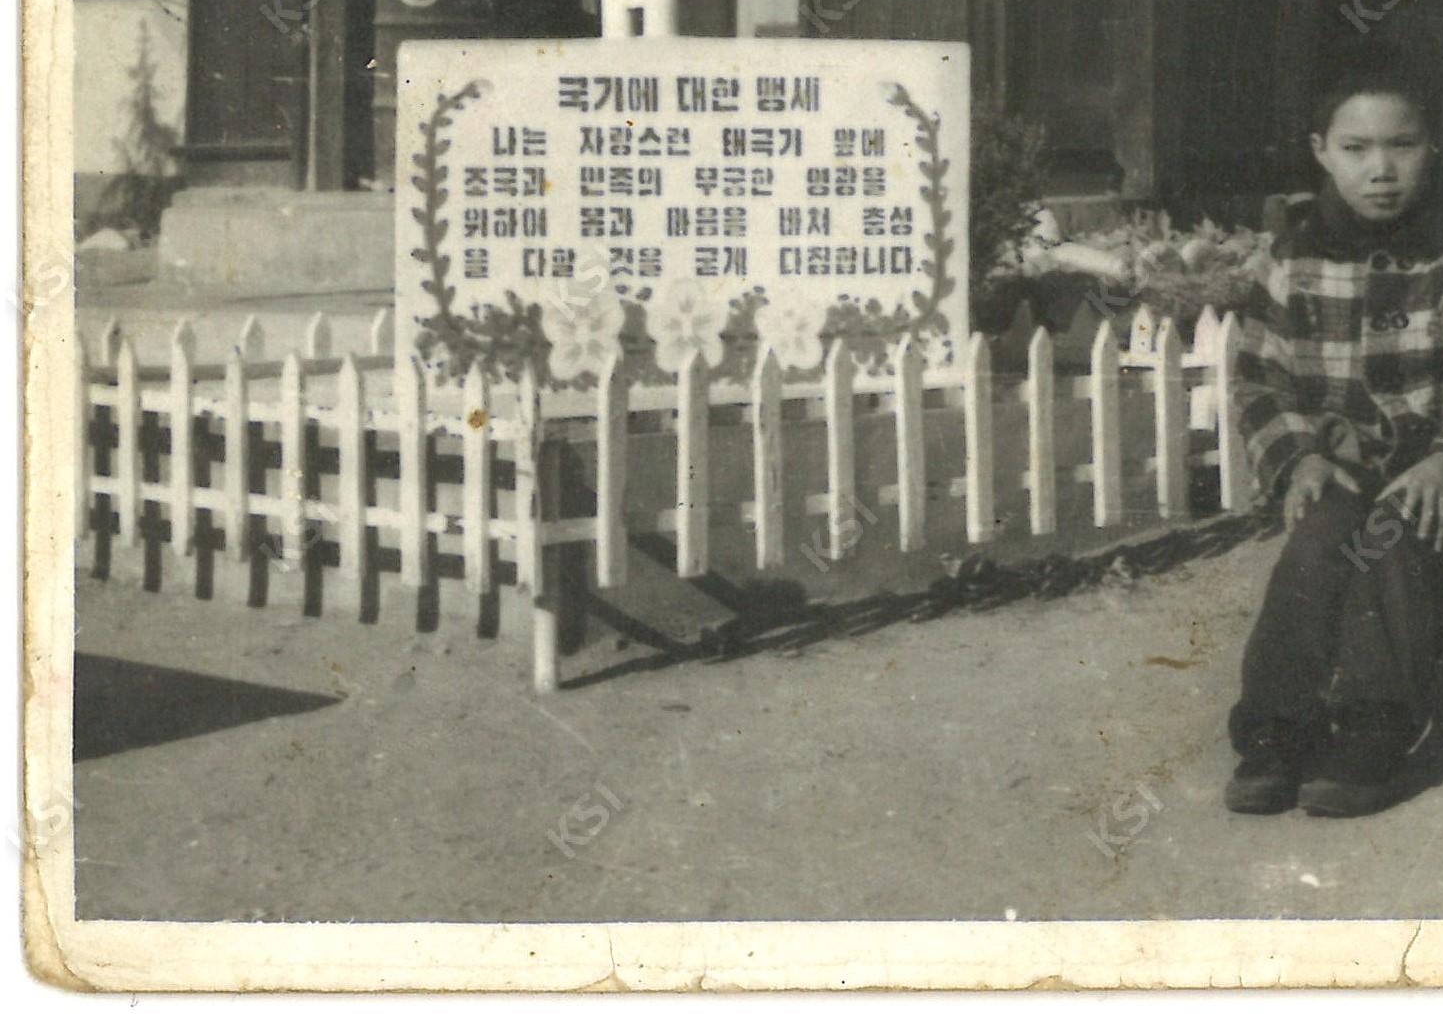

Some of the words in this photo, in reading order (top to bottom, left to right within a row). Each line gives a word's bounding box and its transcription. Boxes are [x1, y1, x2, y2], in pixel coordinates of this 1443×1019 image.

[559, 77, 658, 112] 국기에
[676, 77, 740, 112] 대한
[757, 77, 819, 112] 맹세
[493, 127, 546, 156] 나는
[580, 125, 690, 156] 자랑스런
[722, 128, 802, 157] 태극기
[835, 129, 884, 156] 앞에
[464, 167, 545, 197] 조국과
[580, 167, 661, 196] 민족의
[695, 167, 773, 196] 무궁한
[807, 166, 885, 196] 영광을
[580, 207, 633, 237] 몸과
[667, 207, 746, 236] 마음을
[863, 207, 912, 235] 충성
[464, 249, 488, 278] 을
[523, 248, 576, 278] 다할
[609, 247, 662, 277] 것을
[696, 247, 747, 276] 굳게
